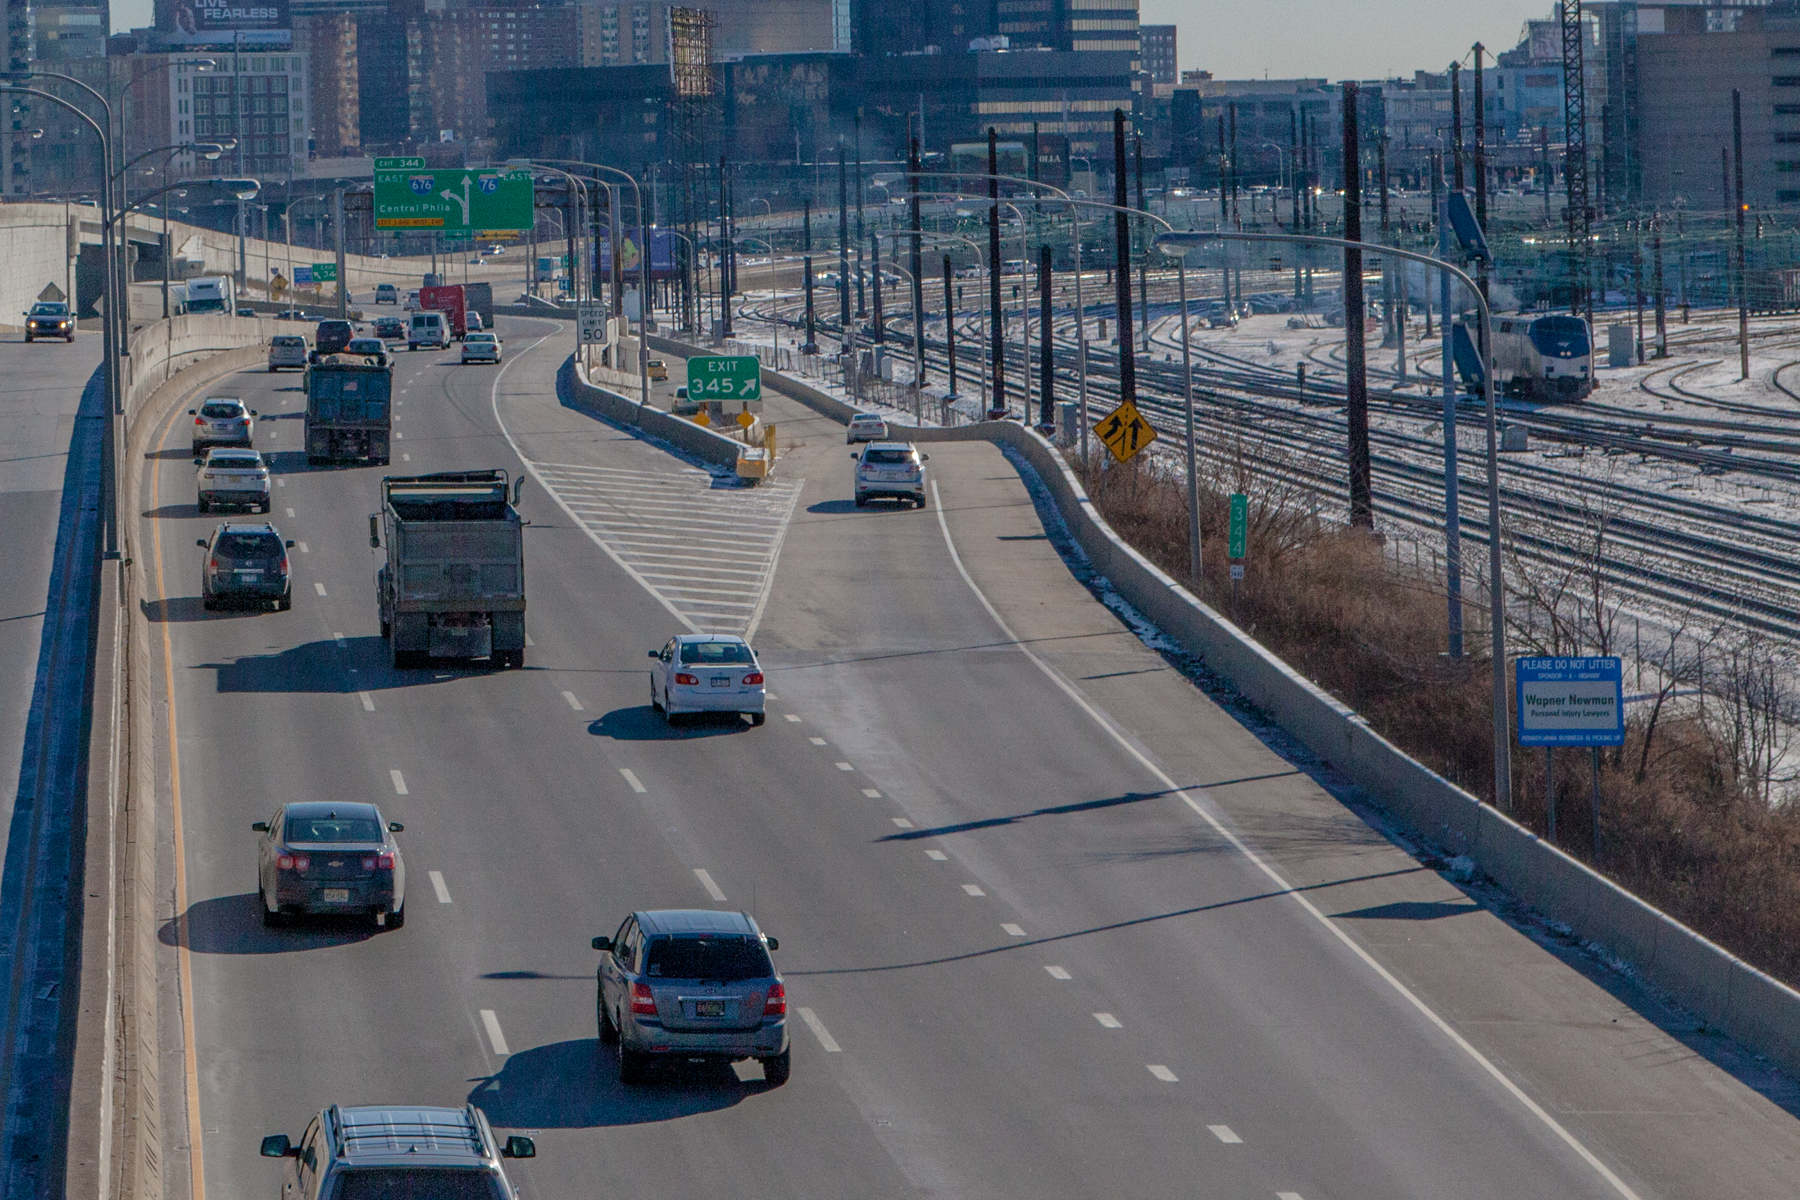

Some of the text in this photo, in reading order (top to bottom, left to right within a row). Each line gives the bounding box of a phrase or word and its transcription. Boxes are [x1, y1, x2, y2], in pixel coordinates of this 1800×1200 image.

[203, 8, 278, 18] FEARLESS
[400, 159, 419, 167] 344
[503, 173, 529, 181] EAST
[411, 181, 432, 190] 676
[480, 179, 496, 191] 76
[379, 203, 450, 212] Central Phila
[560, 280, 568, 288] H
[583, 328, 603, 341] 50
[708, 361, 738, 371] EXIT
[692, 378, 734, 393] 345
[1234, 506, 1243, 555] 344
[1522, 660, 1616, 670] PLEASE DO NOT LITTER
[1525, 694, 1614, 708] Wapner Newman
[1531, 709, 1610, 718] Personal Injury Lawyers
